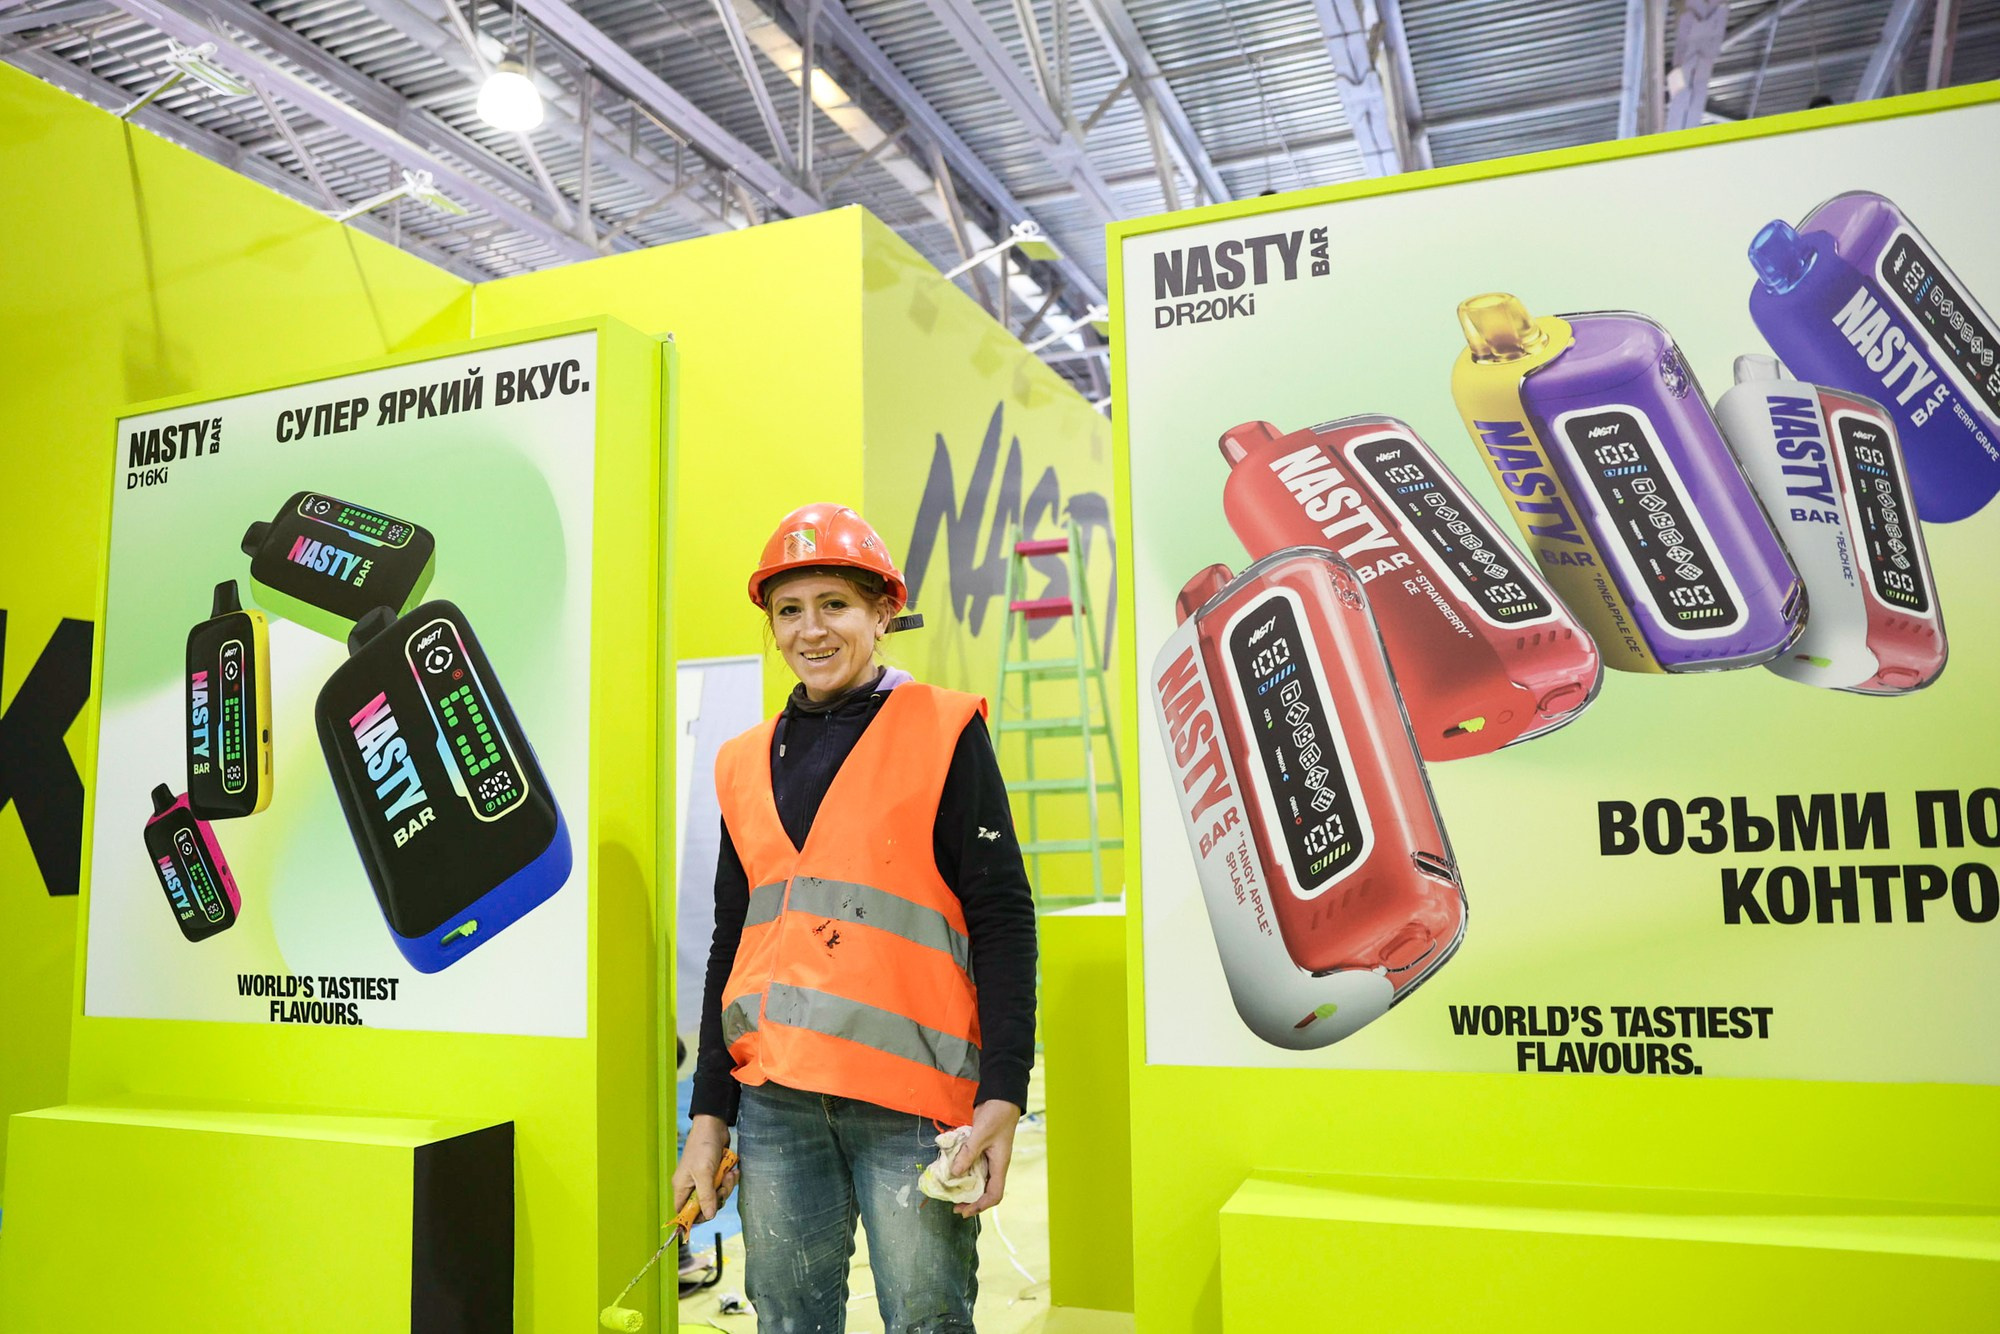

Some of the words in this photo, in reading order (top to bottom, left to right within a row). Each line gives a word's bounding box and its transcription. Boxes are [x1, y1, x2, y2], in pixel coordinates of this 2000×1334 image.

[1153, 230, 1304, 300] NASTY
[1309, 226, 1330, 276] BAR
[1155, 293, 1255, 329] DR20Ki
[1832, 285, 1939, 406] NASTY
[277, 397, 369, 443] СУПЕР
[377, 367, 482, 427] ЯРКИЙ
[495, 359, 590, 406] ВКУС.
[1910, 384, 1950, 427] BAR
[128, 419, 209, 468] NASTY
[209, 416, 222, 454] BAR
[1588, 424, 1620, 438] NASTY
[1376, 449, 1401, 463] NASTY
[1595, 442, 1639, 464] 100
[1766, 396, 1837, 506] NASTY
[1854, 446, 1884, 466] 100
[127, 468, 168, 489] D16Ki
[1385, 464, 1424, 483] 100
[1473, 420, 1585, 547] NASTY
[1269, 444, 1412, 560] NASTY
[1790, 508, 1841, 526] BAR
[287, 535, 362, 581] NASTY
[353, 559, 374, 587] BAR
[1358, 552, 1414, 585] BAR
[1541, 547, 1596, 568] BAR
[1402, 579, 1421, 596] ICE
[1484, 582, 1527, 603] 100
[1669, 585, 1715, 607] 100
[1883, 570, 1914, 592] 100
[1416, 569, 1474, 638] "STRAWBERRY"
[417, 627, 442, 652] NASTY
[1248, 616, 1276, 647] NASTY
[1252, 637, 1290, 679] 100
[192, 670, 210, 758] NASTY
[1158, 645, 1233, 824] NASTY
[194, 763, 210, 775] BAR
[349, 691, 428, 822] NASTY
[393, 806, 437, 849] BAR
[1199, 806, 1241, 860] BAR
[1304, 813, 1344, 856] 100
[1597, 792, 1891, 856] ВОЗЬМИ
[158, 855, 191, 909] NASTY
[1225, 851, 1246, 905] SPLASH
[180, 909, 195, 921] BAR
[237, 974, 314, 998] WORLD'S
[318, 976, 399, 1000] TASTIEST
[270, 1000, 363, 1026] FLAVOURS.
[1448, 1005, 1603, 1037] WORLD'S
[1610, 1006, 1774, 1039] TASTIEST
[1516, 1041, 1703, 1075] FLAVOURS.
